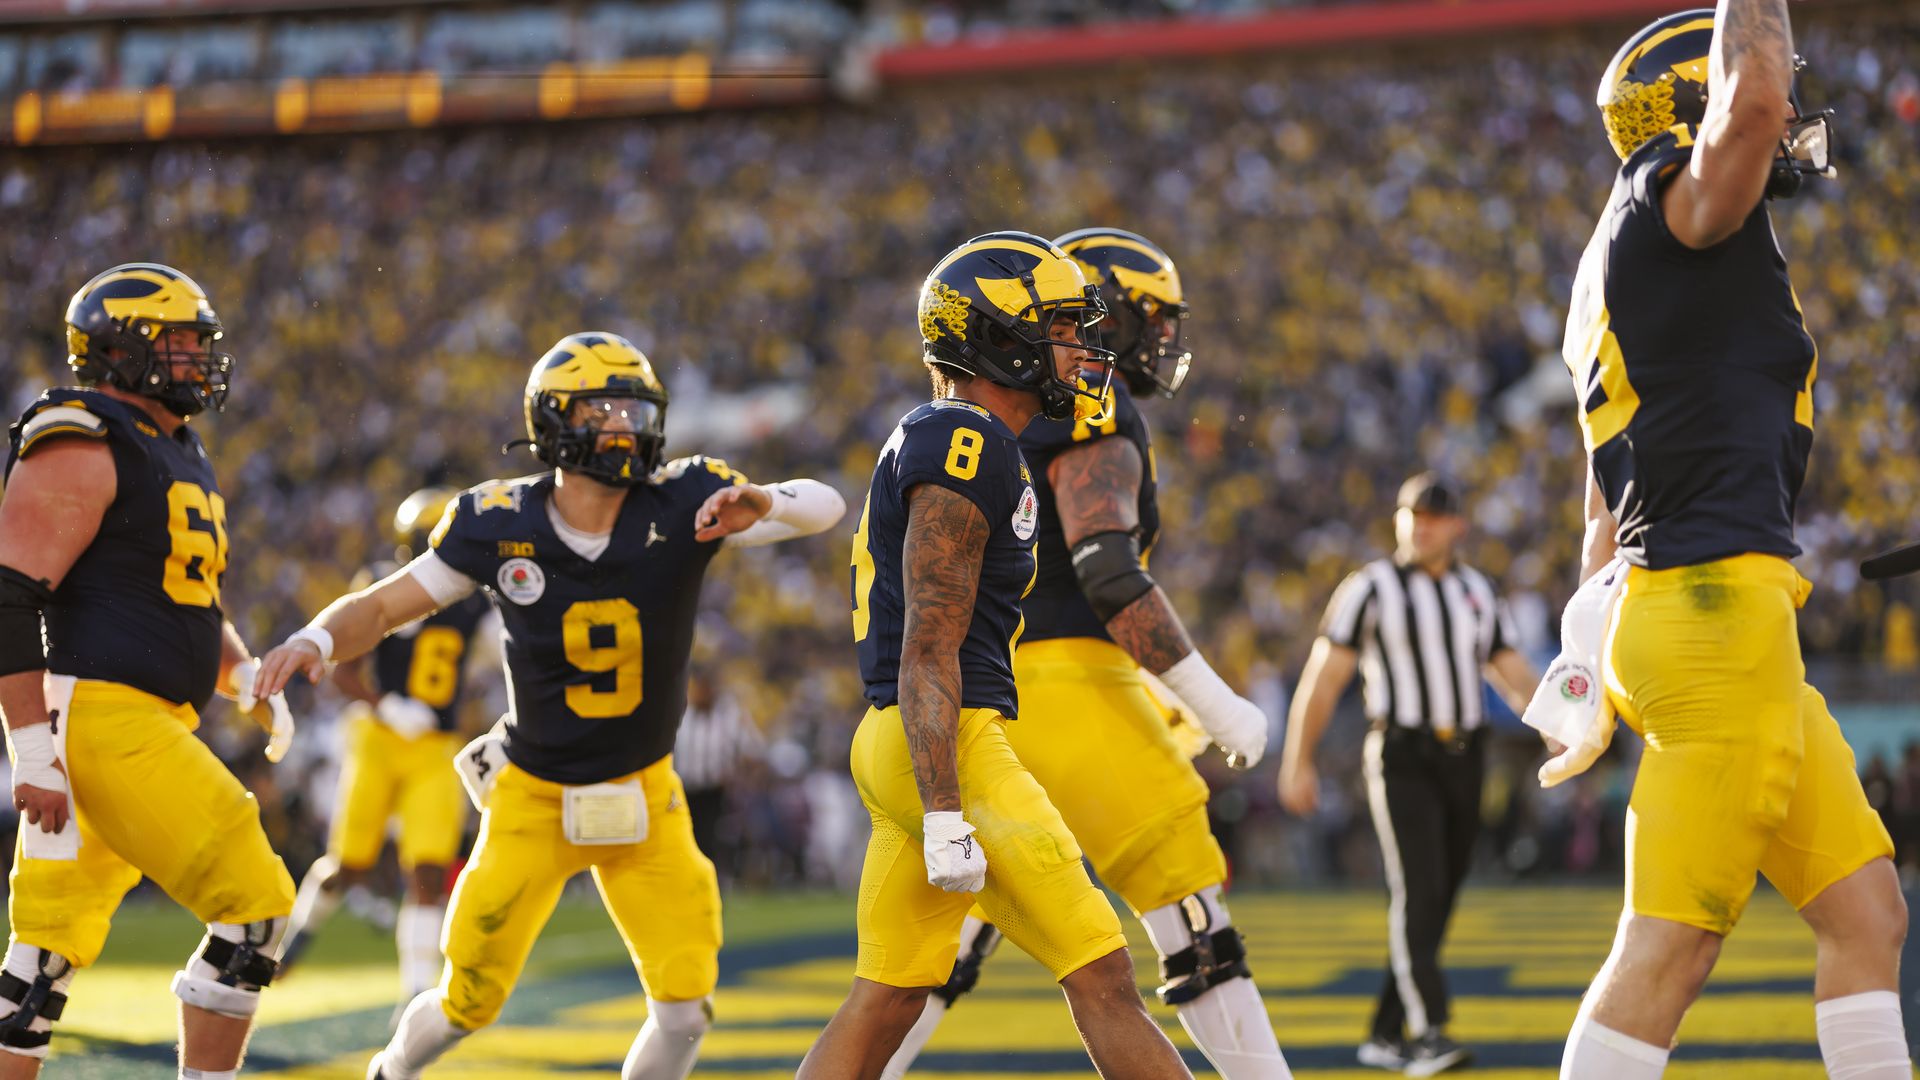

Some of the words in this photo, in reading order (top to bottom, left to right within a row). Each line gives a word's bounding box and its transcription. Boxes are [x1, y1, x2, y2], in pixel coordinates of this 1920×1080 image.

[944, 427, 984, 480] 8
[406, 625, 464, 709] 6
[562, 598, 643, 718] 9
